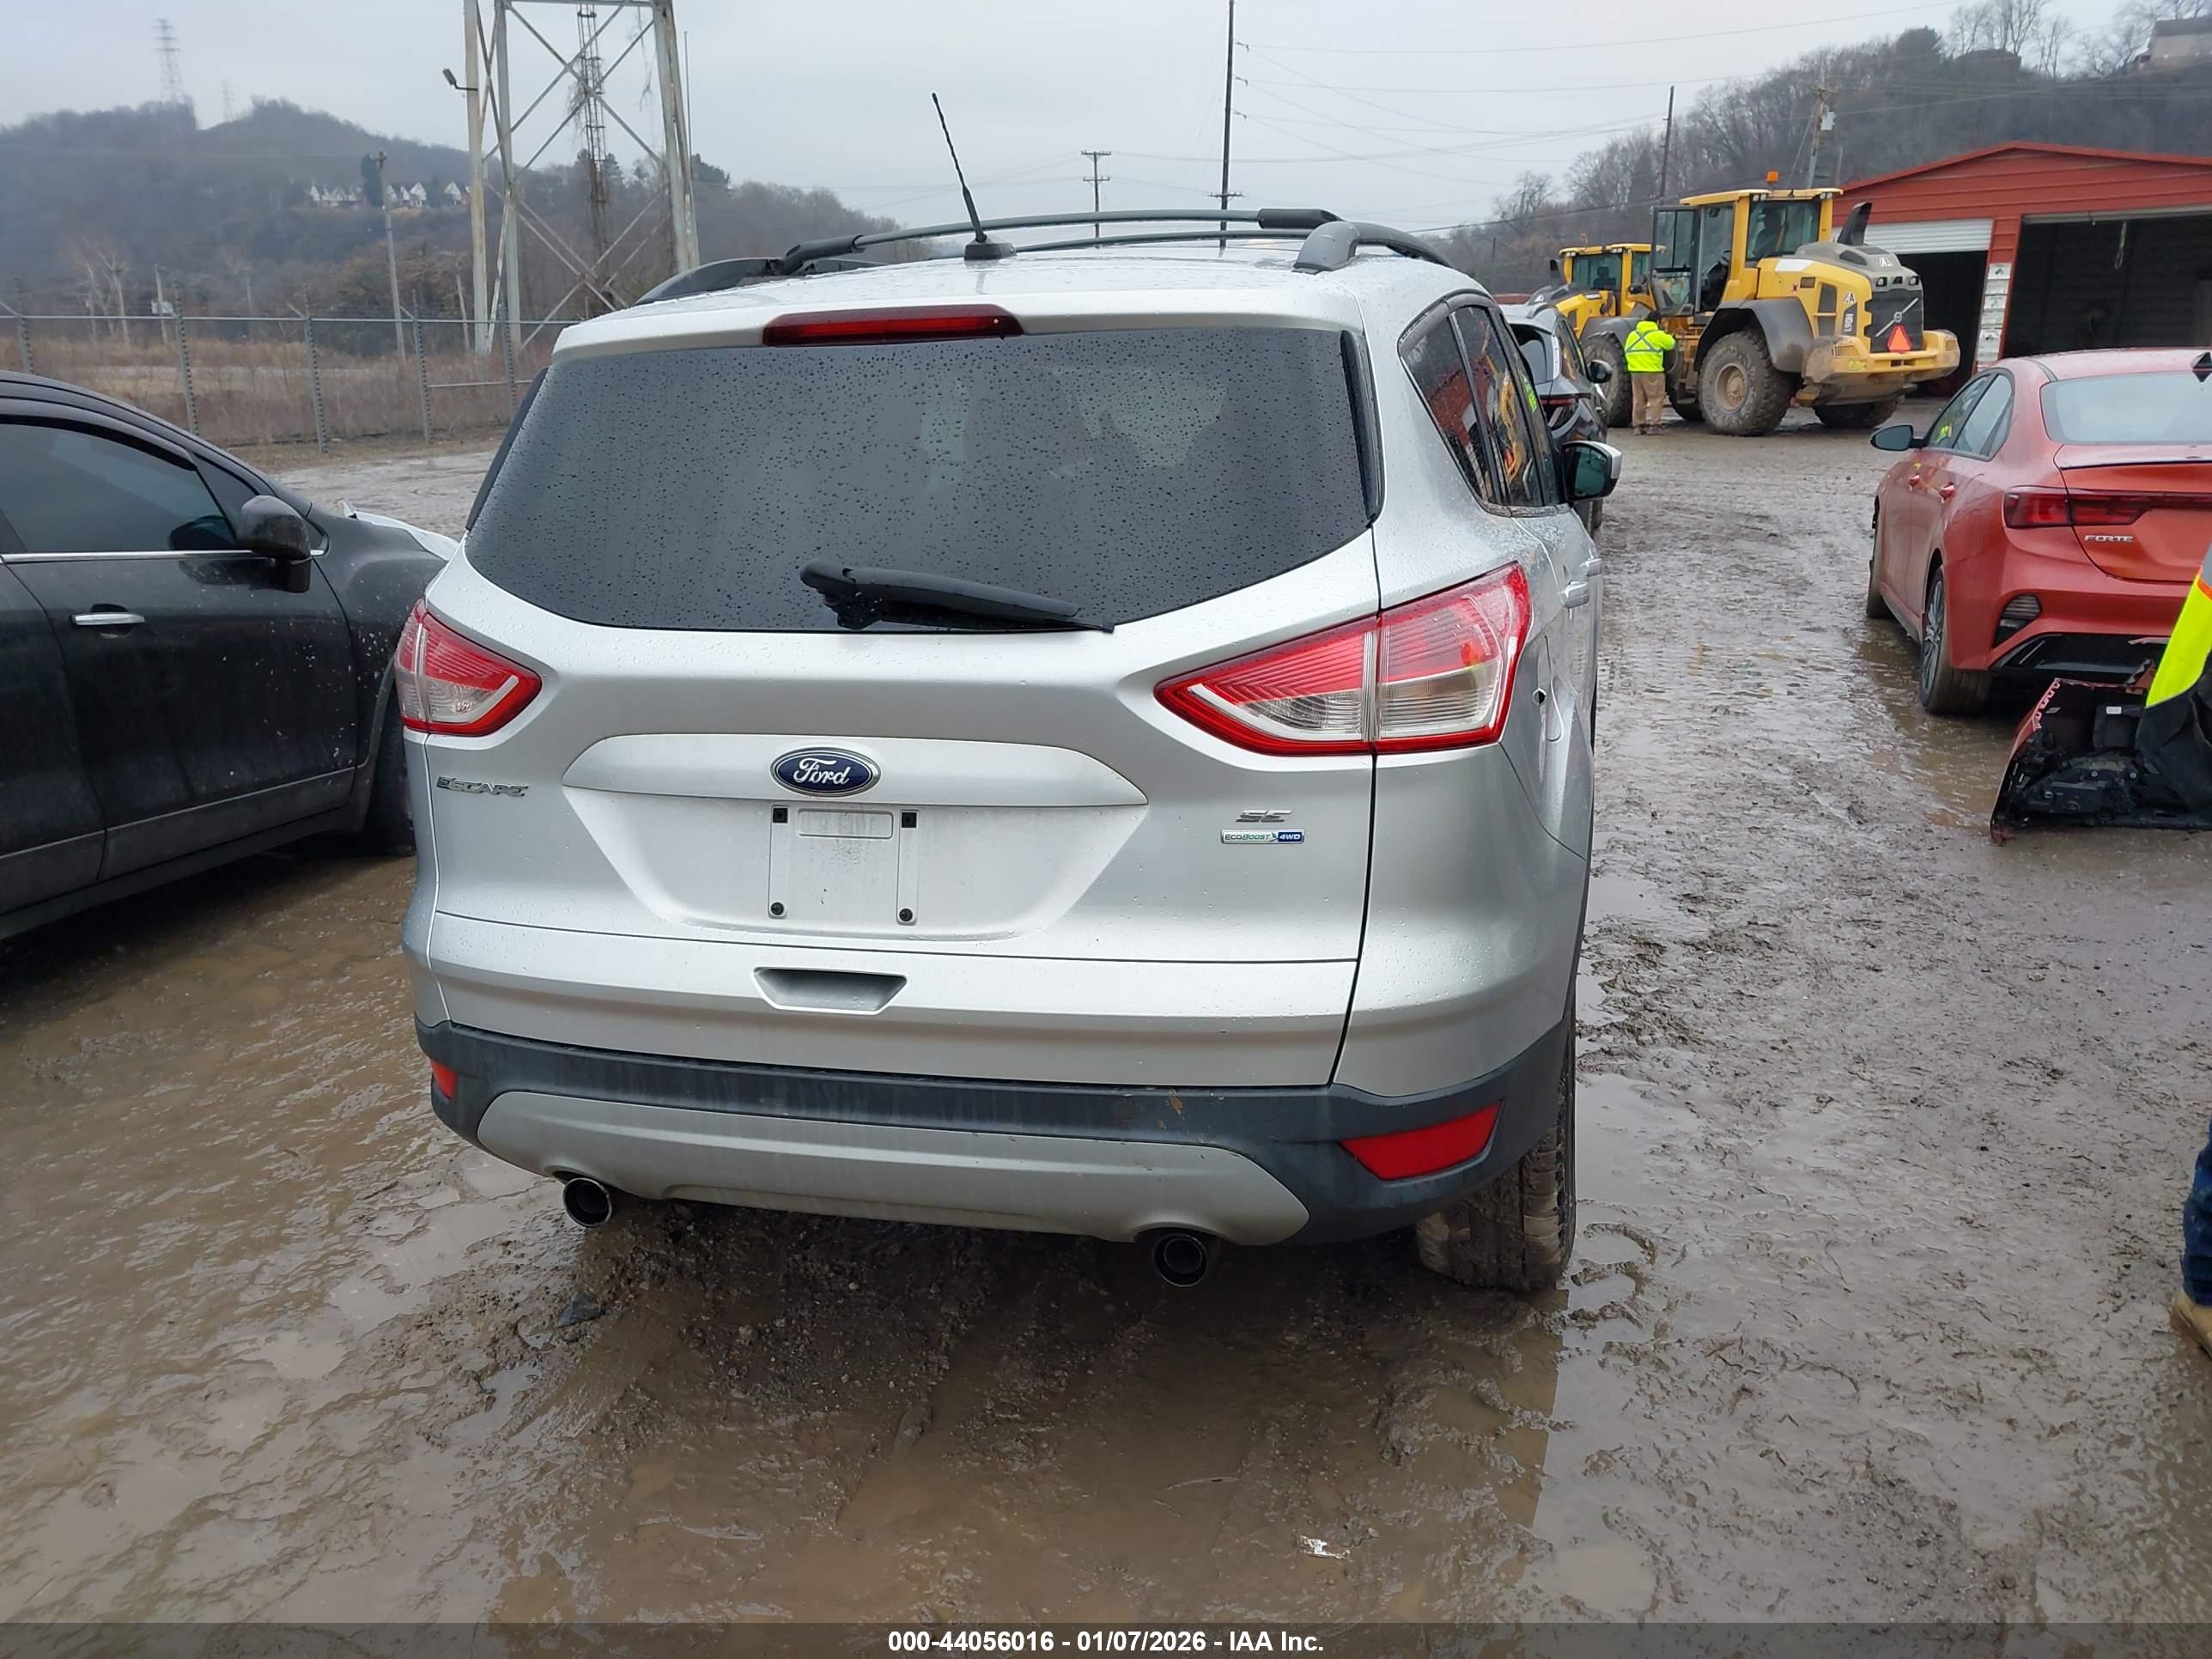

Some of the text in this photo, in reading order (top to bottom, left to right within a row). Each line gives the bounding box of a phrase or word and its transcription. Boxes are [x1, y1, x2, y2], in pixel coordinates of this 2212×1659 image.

[2084, 534, 2135, 543] FORTE
[793, 757, 851, 785] Ford
[436, 775, 530, 798] ESCAPE
[1235, 809, 1293, 823] SE
